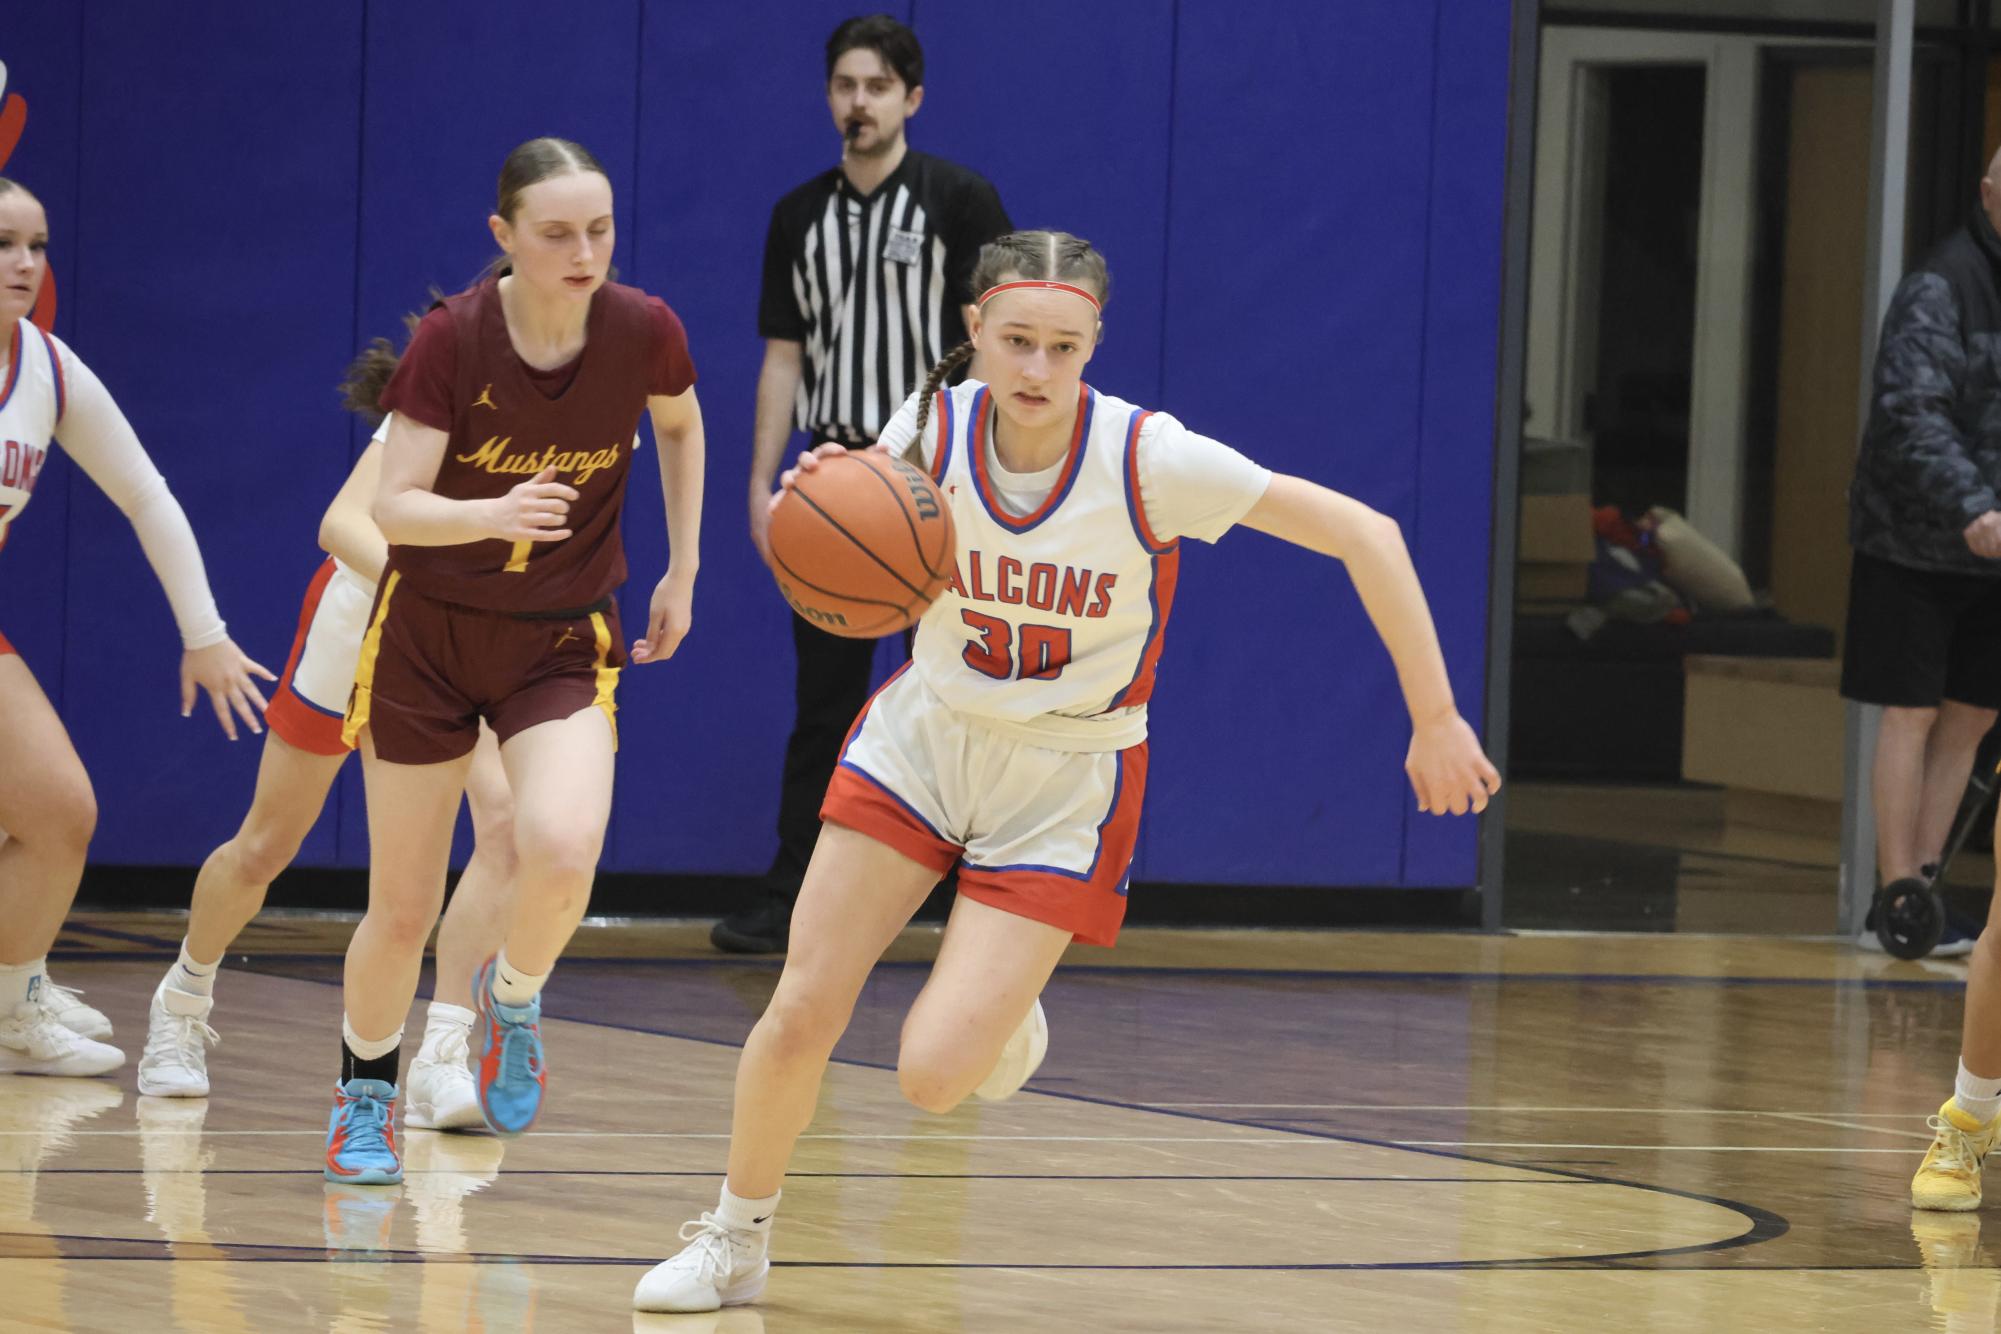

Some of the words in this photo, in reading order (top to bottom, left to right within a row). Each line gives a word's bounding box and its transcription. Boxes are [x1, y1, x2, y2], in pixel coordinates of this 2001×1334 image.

[456, 435, 621, 486] Mustangs
[945, 550, 1119, 619] ALCONS
[960, 608, 1072, 681] 30
